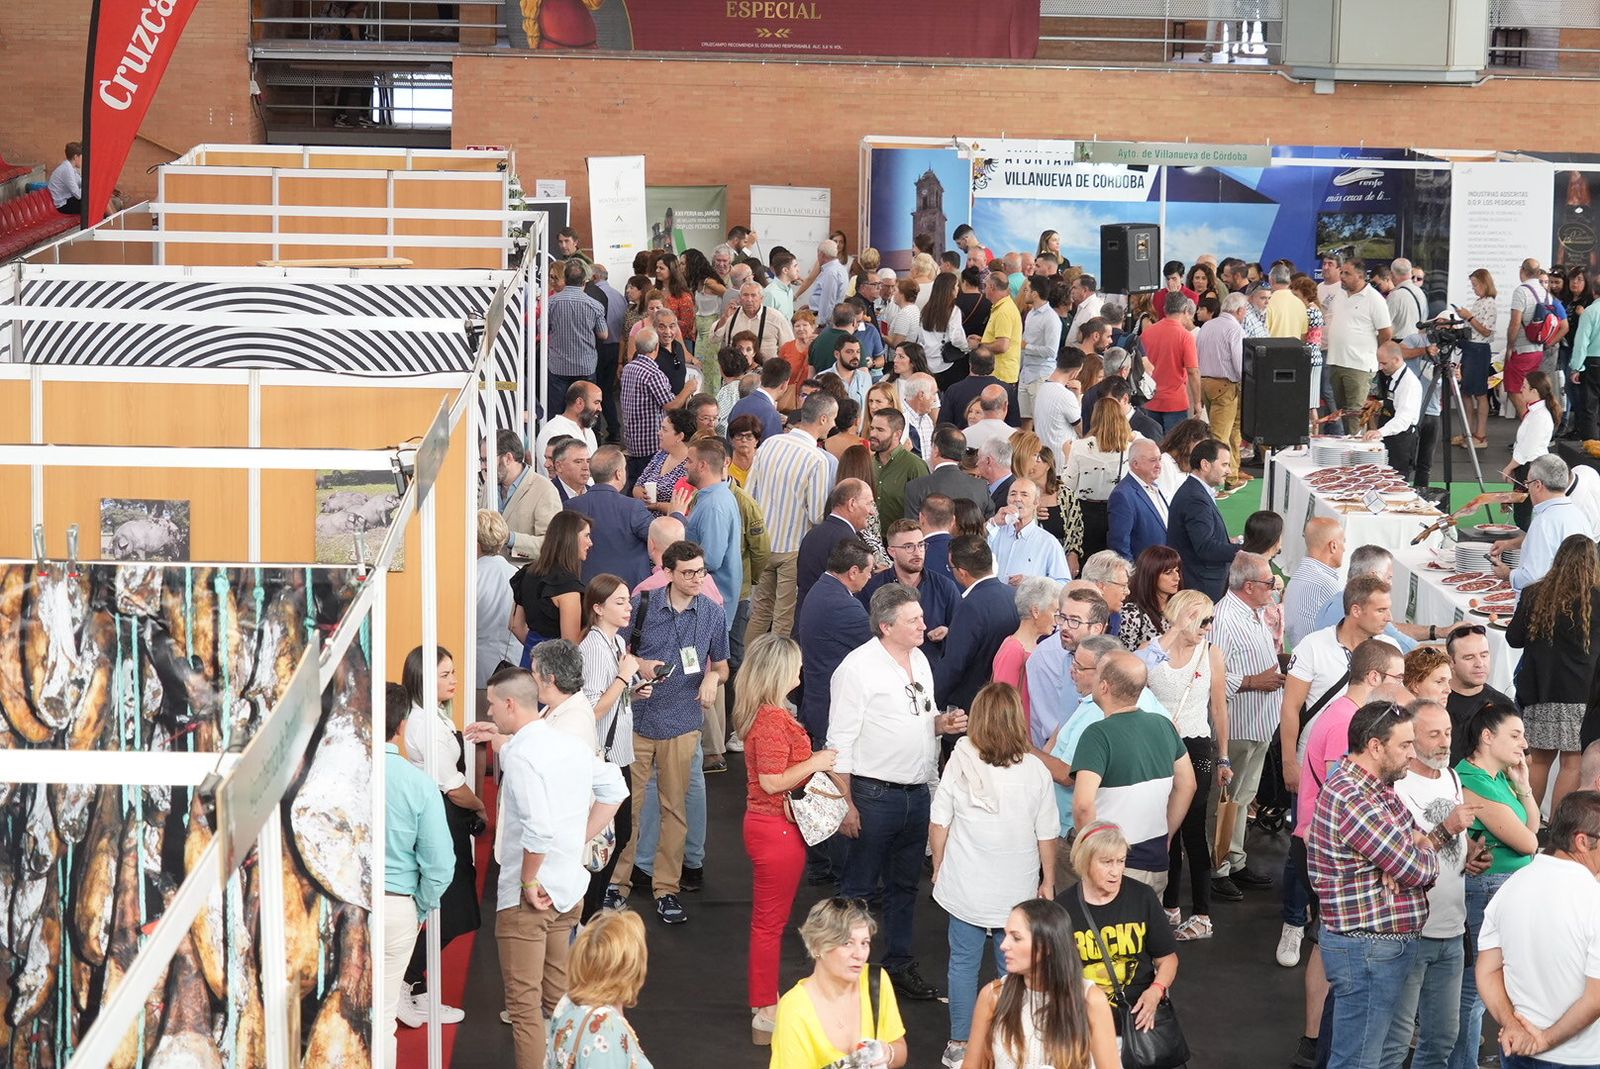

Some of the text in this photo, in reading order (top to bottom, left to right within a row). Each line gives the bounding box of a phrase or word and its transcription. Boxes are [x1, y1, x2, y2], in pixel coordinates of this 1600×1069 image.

[726, 0, 822, 20] ESPECIAL
[1118, 148, 1248, 161] Ayto. de Villanueva de Córdoba
[1004, 171, 1073, 188] VILLANUEVA
[1075, 174, 1090, 188] DE
[1359, 179, 1383, 188] renfe
[1326, 193, 1342, 202] más
[1364, 190, 1375, 201] de
[1073, 921, 1147, 961] ROCKY
